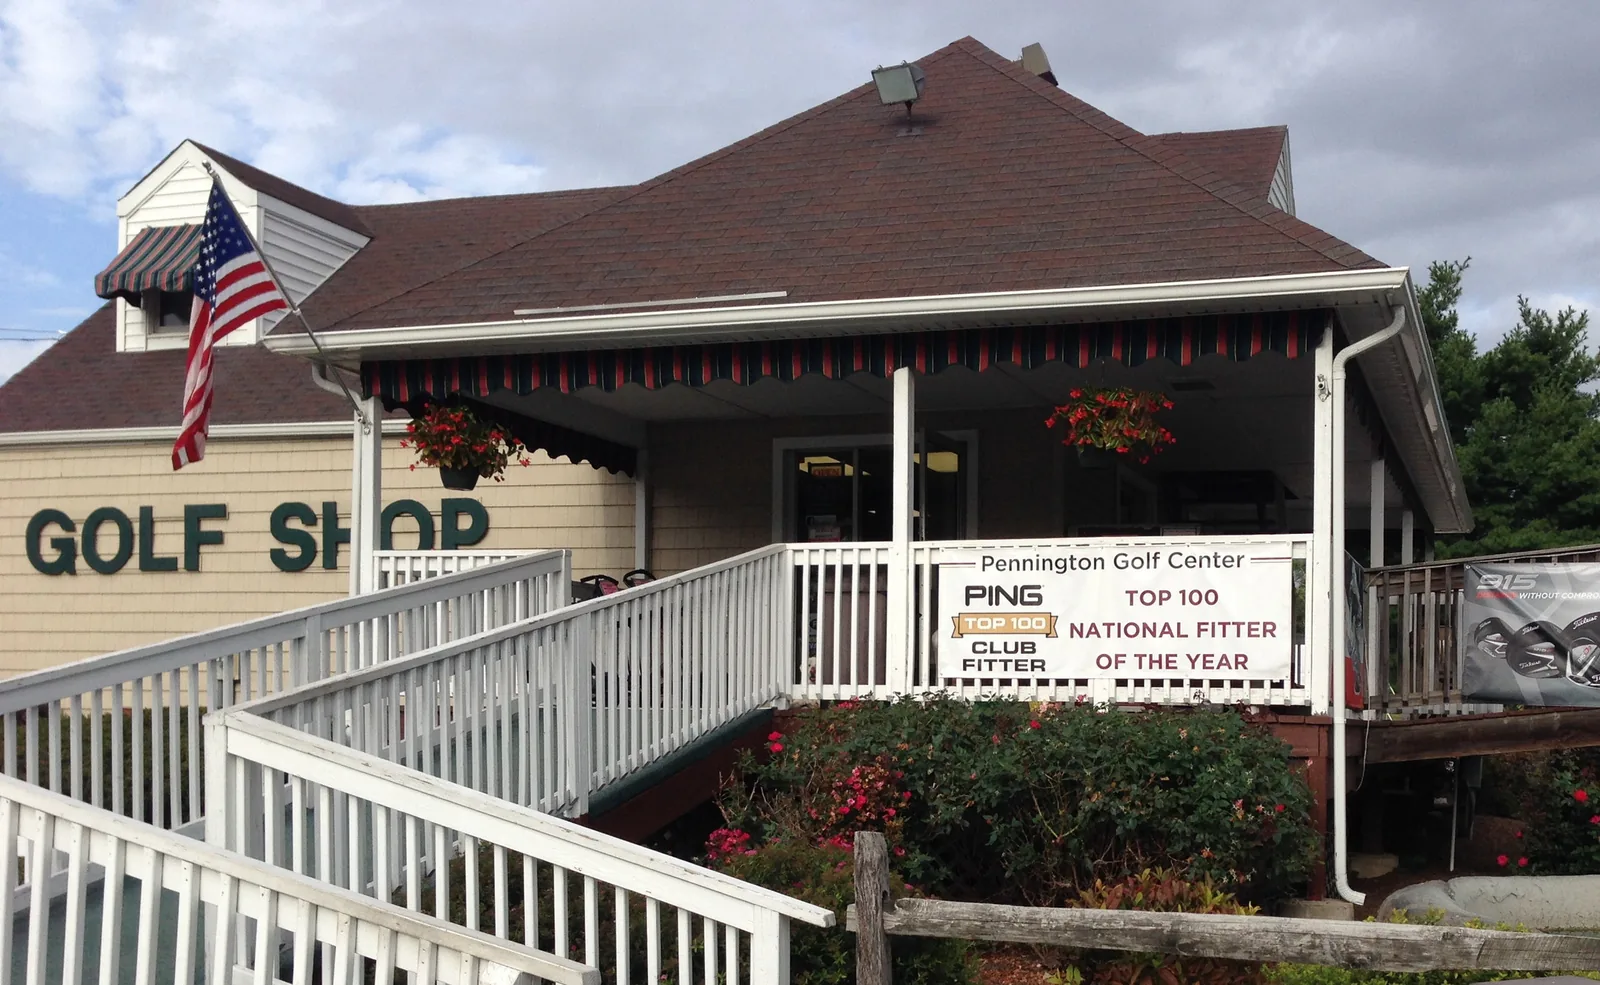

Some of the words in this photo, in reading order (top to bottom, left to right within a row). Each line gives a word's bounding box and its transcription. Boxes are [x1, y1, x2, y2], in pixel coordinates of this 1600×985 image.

[26, 504, 228, 576] GOLF
[270, 498, 490, 571] SHOP
[983, 555, 1104, 574] Pennington
[1114, 552, 1160, 569] Golf
[1169, 552, 1244, 568] Center
[1476, 574, 1539, 590] 915
[965, 585, 1042, 606] PING
[1126, 590, 1171, 606] TOP
[1179, 590, 1218, 605] 100
[1519, 592, 1560, 600] WITHOUT
[1561, 592, 1600, 600] COMPRO
[964, 618, 1005, 629] TOP
[1011, 617, 1046, 629] 100
[1071, 622, 1188, 638] NATIONAL
[1198, 622, 1276, 637] FITTER
[972, 642, 1036, 654] CLUB
[963, 659, 1045, 671] FITTER
[1096, 654, 1126, 669] OF
[1134, 654, 1177, 669] THE
[1186, 654, 1248, 669] YEAR
